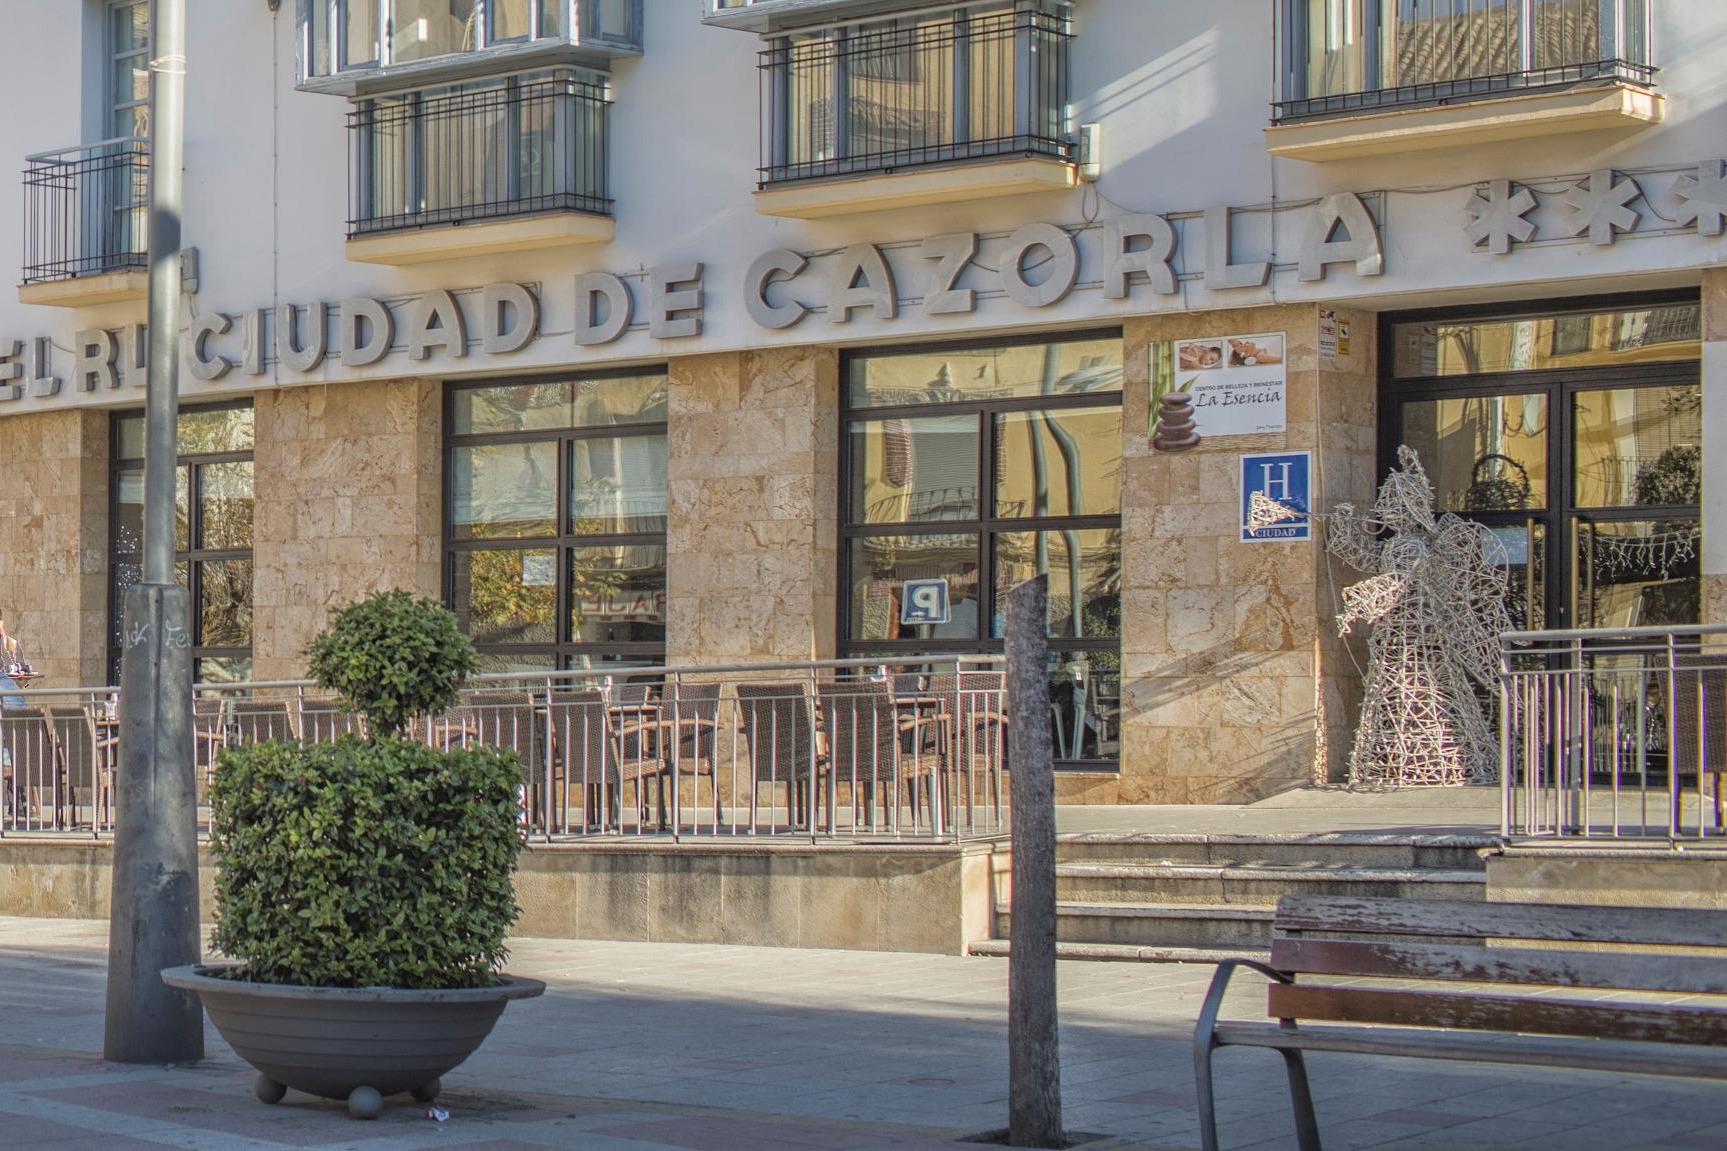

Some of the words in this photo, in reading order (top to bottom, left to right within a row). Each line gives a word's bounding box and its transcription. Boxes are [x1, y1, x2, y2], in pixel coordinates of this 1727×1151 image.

[189, 281, 540, 381] CIUDAD
[574, 262, 704, 346] DE
[743, 191, 1385, 330] CAZORLA
[1253, 380, 1283, 388] BIENESTAR
[1195, 393, 1218, 407] La
[1221, 388, 1282, 407] Esencia
[1260, 462, 1293, 500] H
[1256, 528, 1297, 538] CIUDAD
